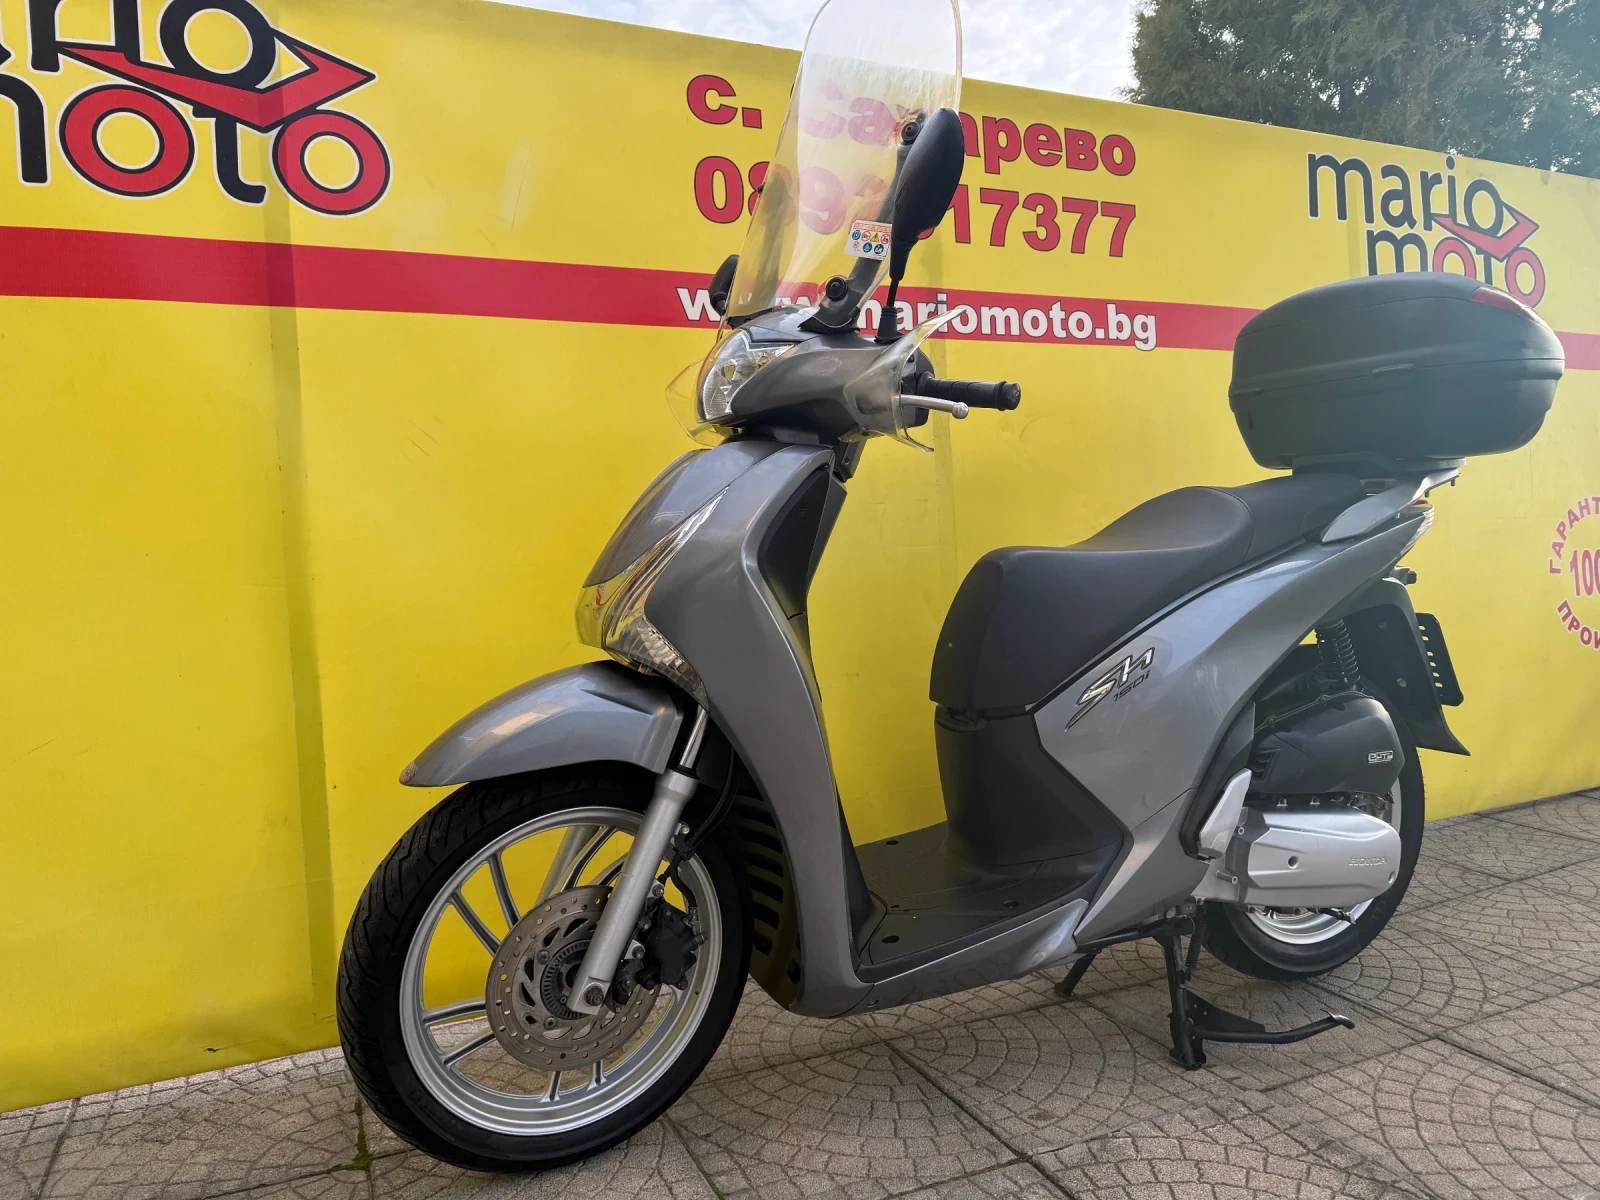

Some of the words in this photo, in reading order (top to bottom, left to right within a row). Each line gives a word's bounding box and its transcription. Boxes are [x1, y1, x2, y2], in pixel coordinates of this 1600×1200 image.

[791, 76, 1136, 177] Сарево
[693, 155, 1137, 258] 08917377
[1307, 152, 1505, 237] mario
[1366, 229, 1546, 309] moto
[1112, 669, 1151, 702] 150i
[1348, 856, 1387, 867] HONDA
